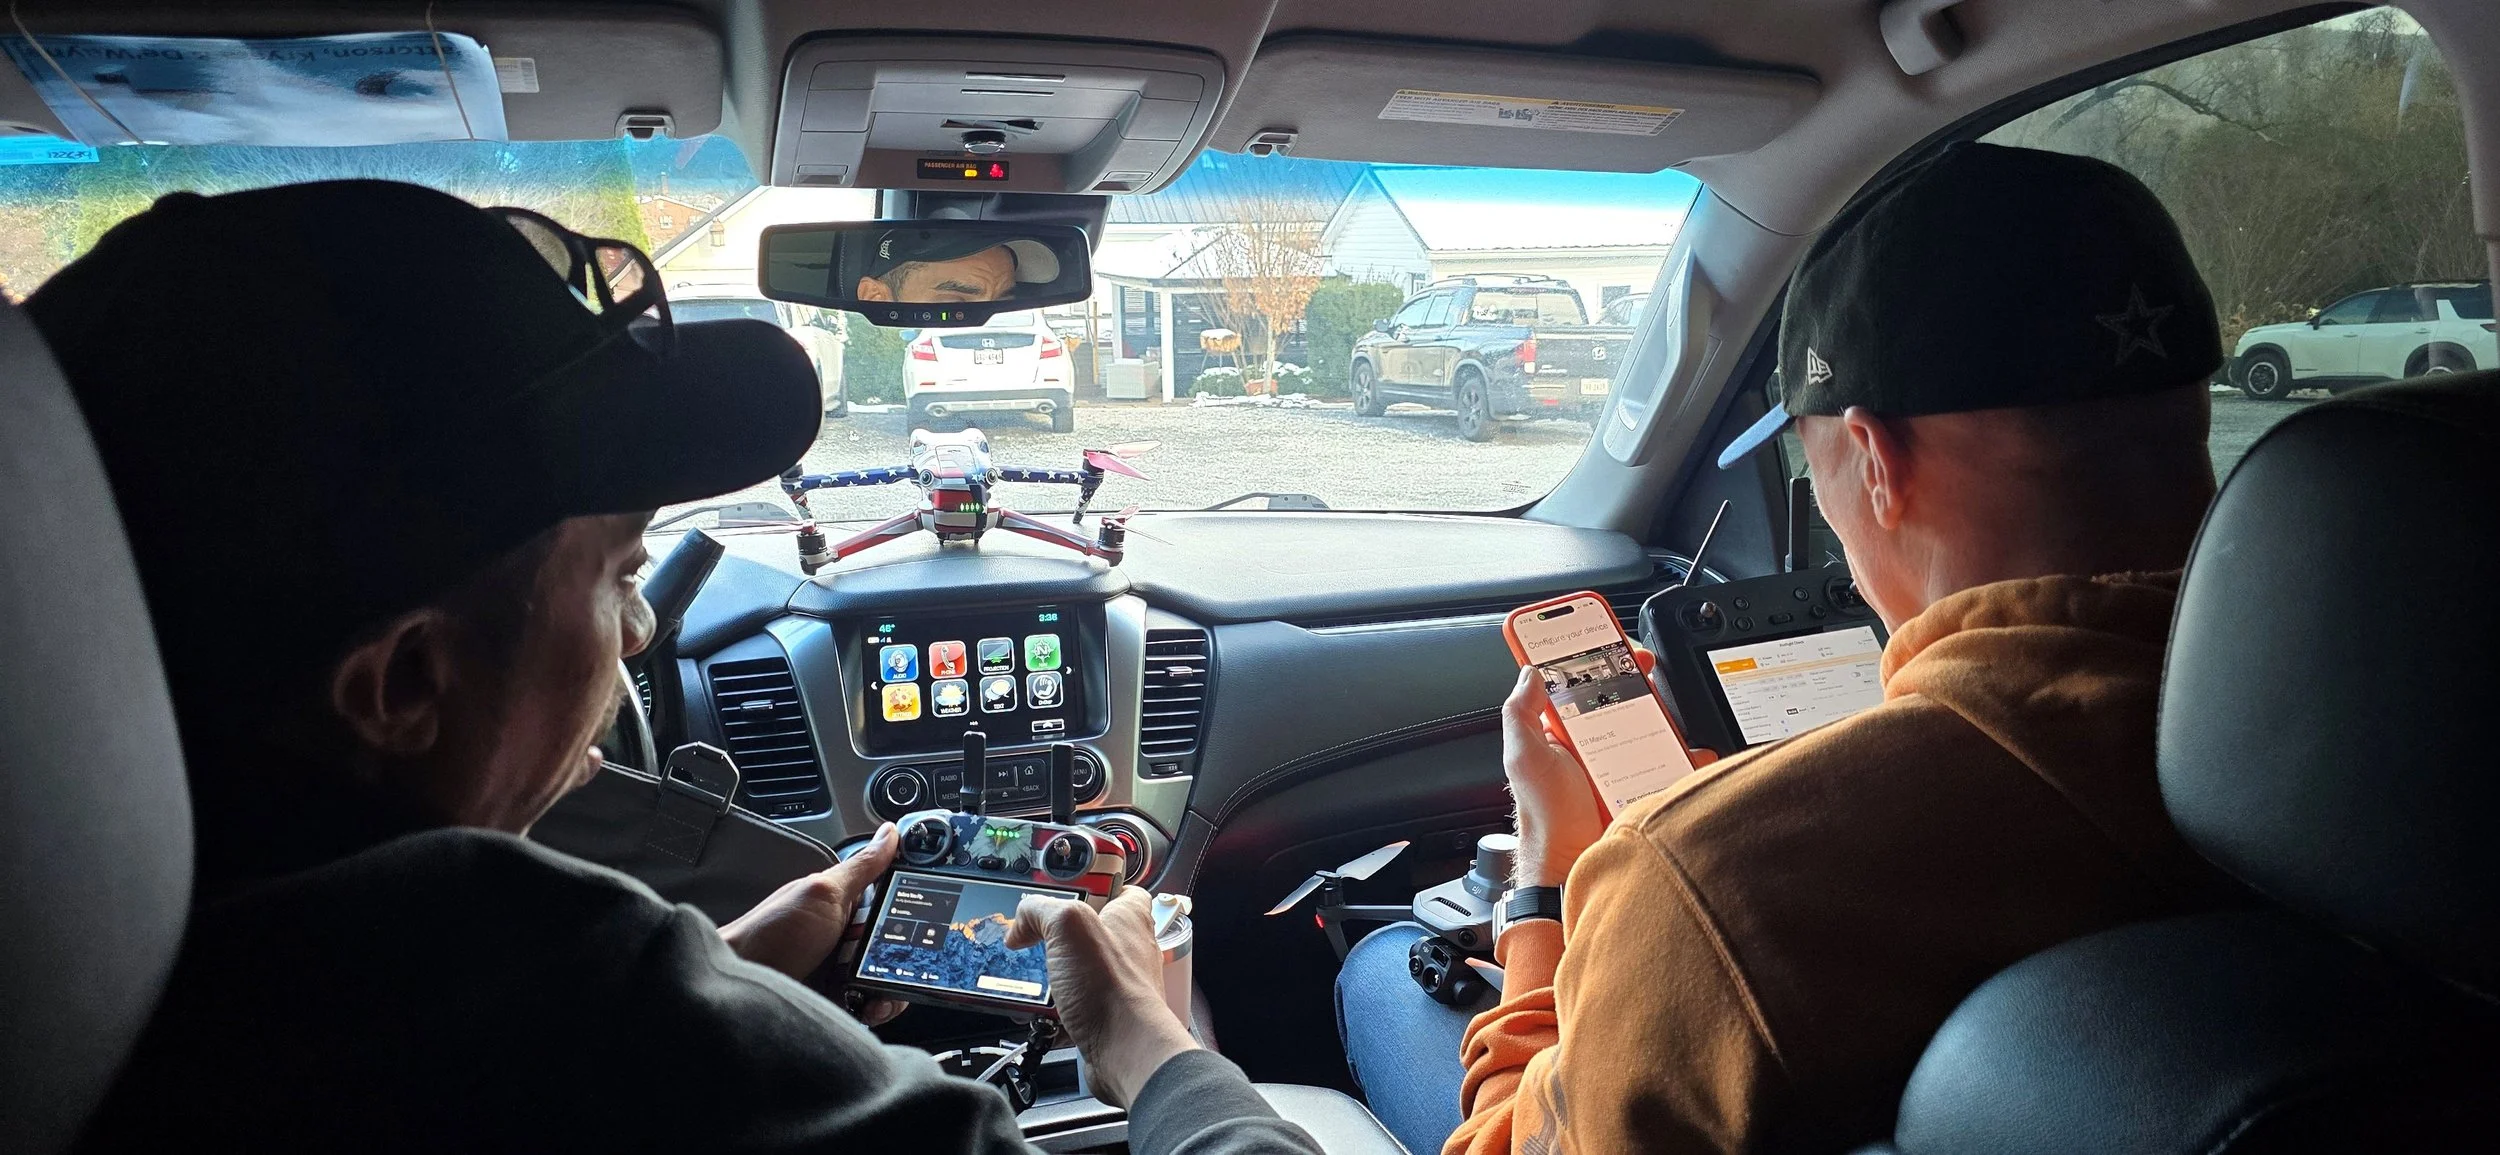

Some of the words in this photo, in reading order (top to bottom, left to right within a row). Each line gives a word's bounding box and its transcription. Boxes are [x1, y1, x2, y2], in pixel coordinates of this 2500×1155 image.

[1528, 633, 1566, 650] Configure
[1566, 630, 1582, 641] your
[1584, 623, 1609, 635] device
[983, 664, 1010, 672] PROJECTION
[1579, 738, 1590, 747] DJI
[1589, 734, 1608, 744] Mavic
[940, 774, 958, 782] RADIO
[941, 792, 960, 800] MEDIA
